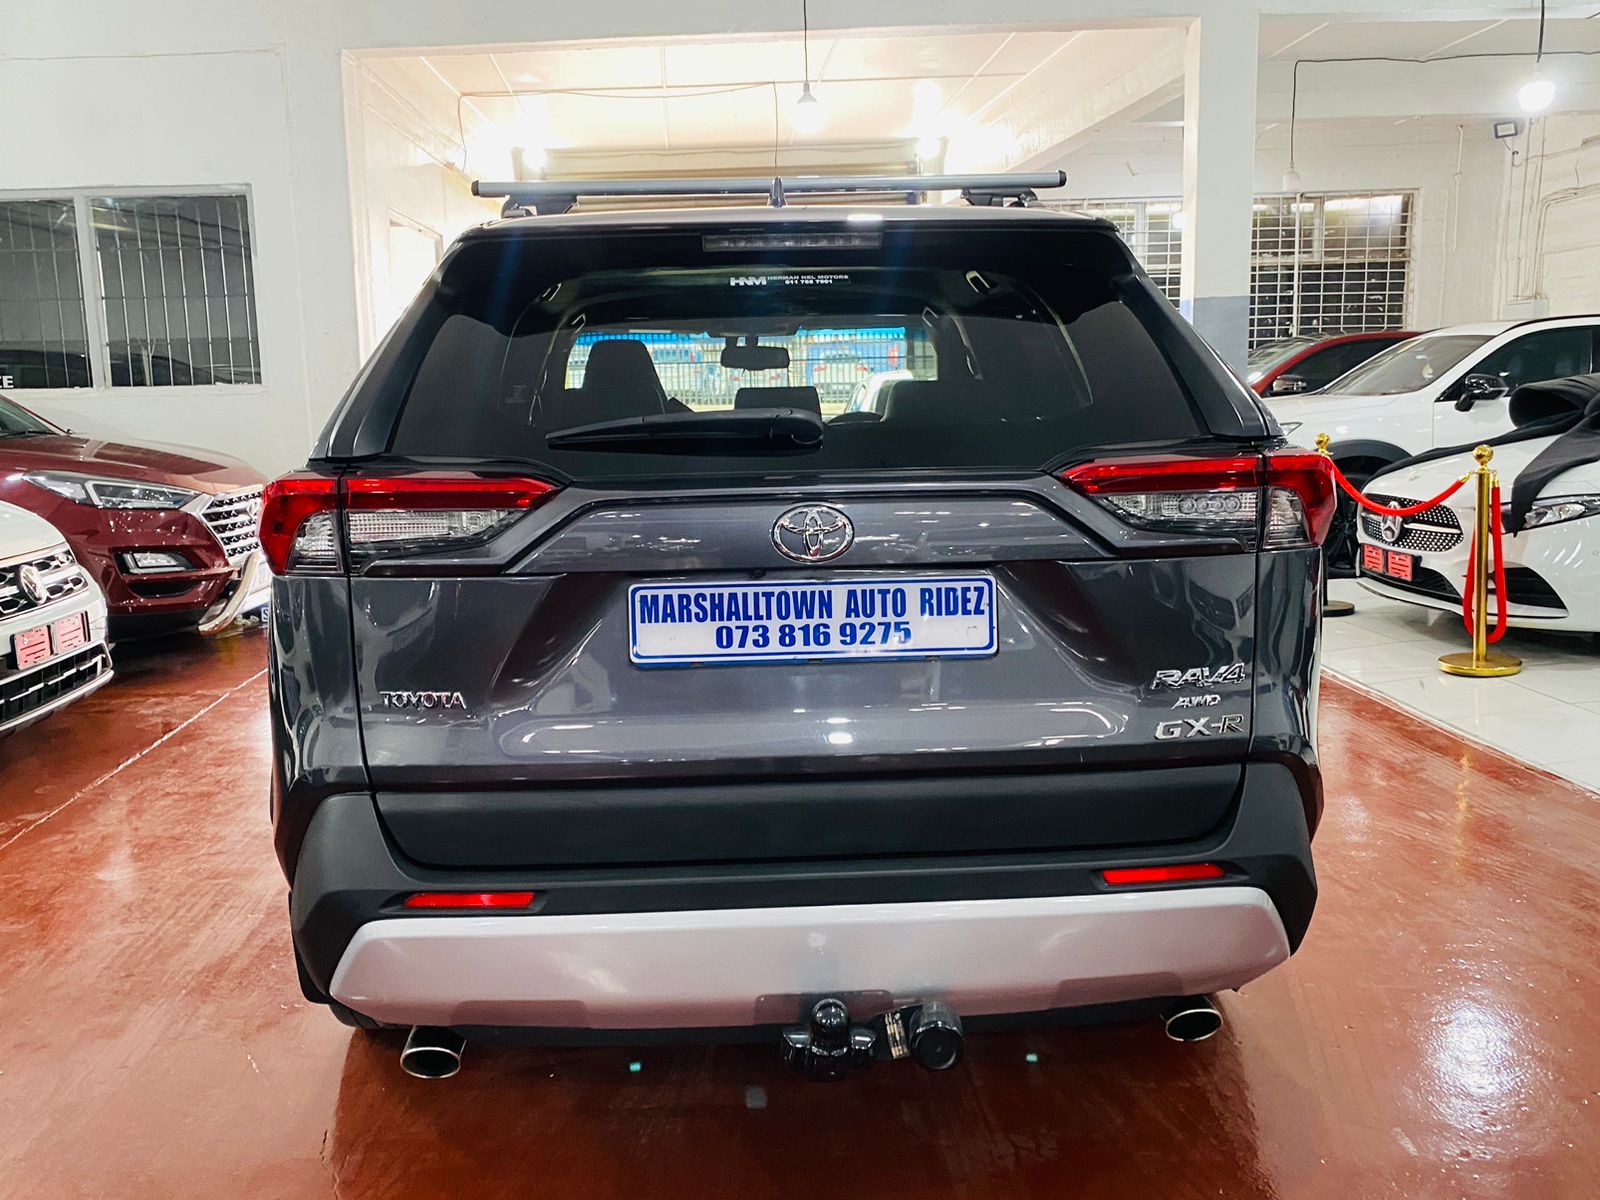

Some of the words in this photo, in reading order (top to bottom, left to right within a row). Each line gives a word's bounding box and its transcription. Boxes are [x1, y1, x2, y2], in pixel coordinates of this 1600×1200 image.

[639, 590, 833, 624] MARSHALLTOWN
[845, 587, 907, 618] AUTO
[919, 586, 985, 616] RIDEZ
[715, 625, 770, 649] 073
[778, 623, 831, 646] 816
[839, 621, 912, 645] 9275
[1151, 662, 1246, 690] RAV4
[379, 691, 467, 709] TOYOTA
[1170, 694, 1221, 710] AWD
[1154, 713, 1245, 740] GX-R
